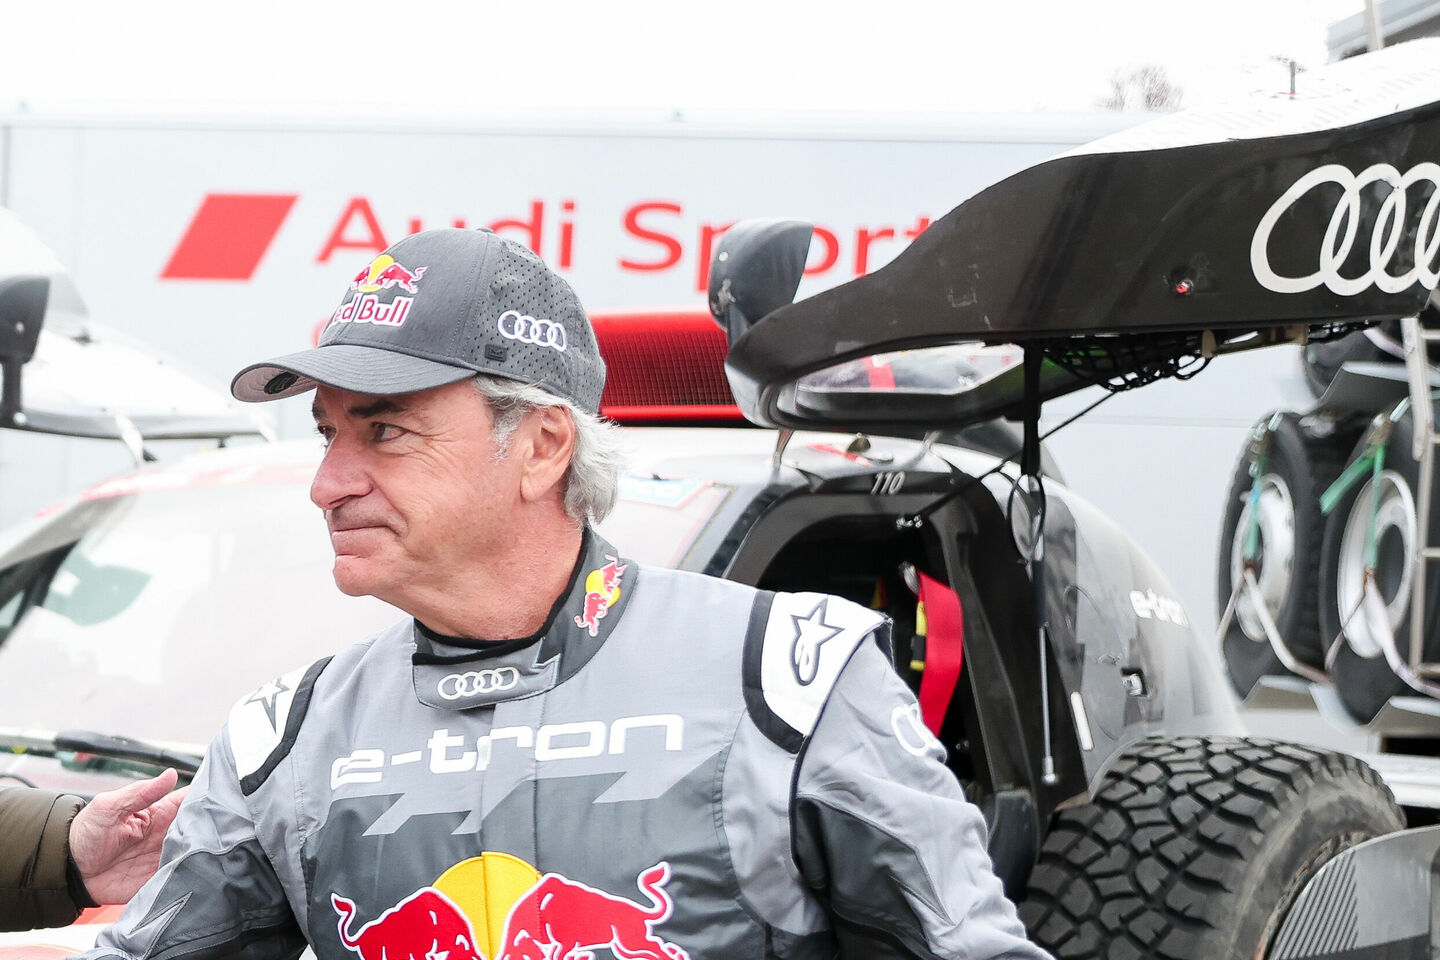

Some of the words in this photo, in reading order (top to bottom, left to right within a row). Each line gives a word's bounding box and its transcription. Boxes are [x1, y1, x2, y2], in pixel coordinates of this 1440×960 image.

[315, 197, 575, 268] Adi
[357, 296, 412, 327] Bull
[871, 472, 905, 495] 110
[331, 713, 683, 791] e-tron
